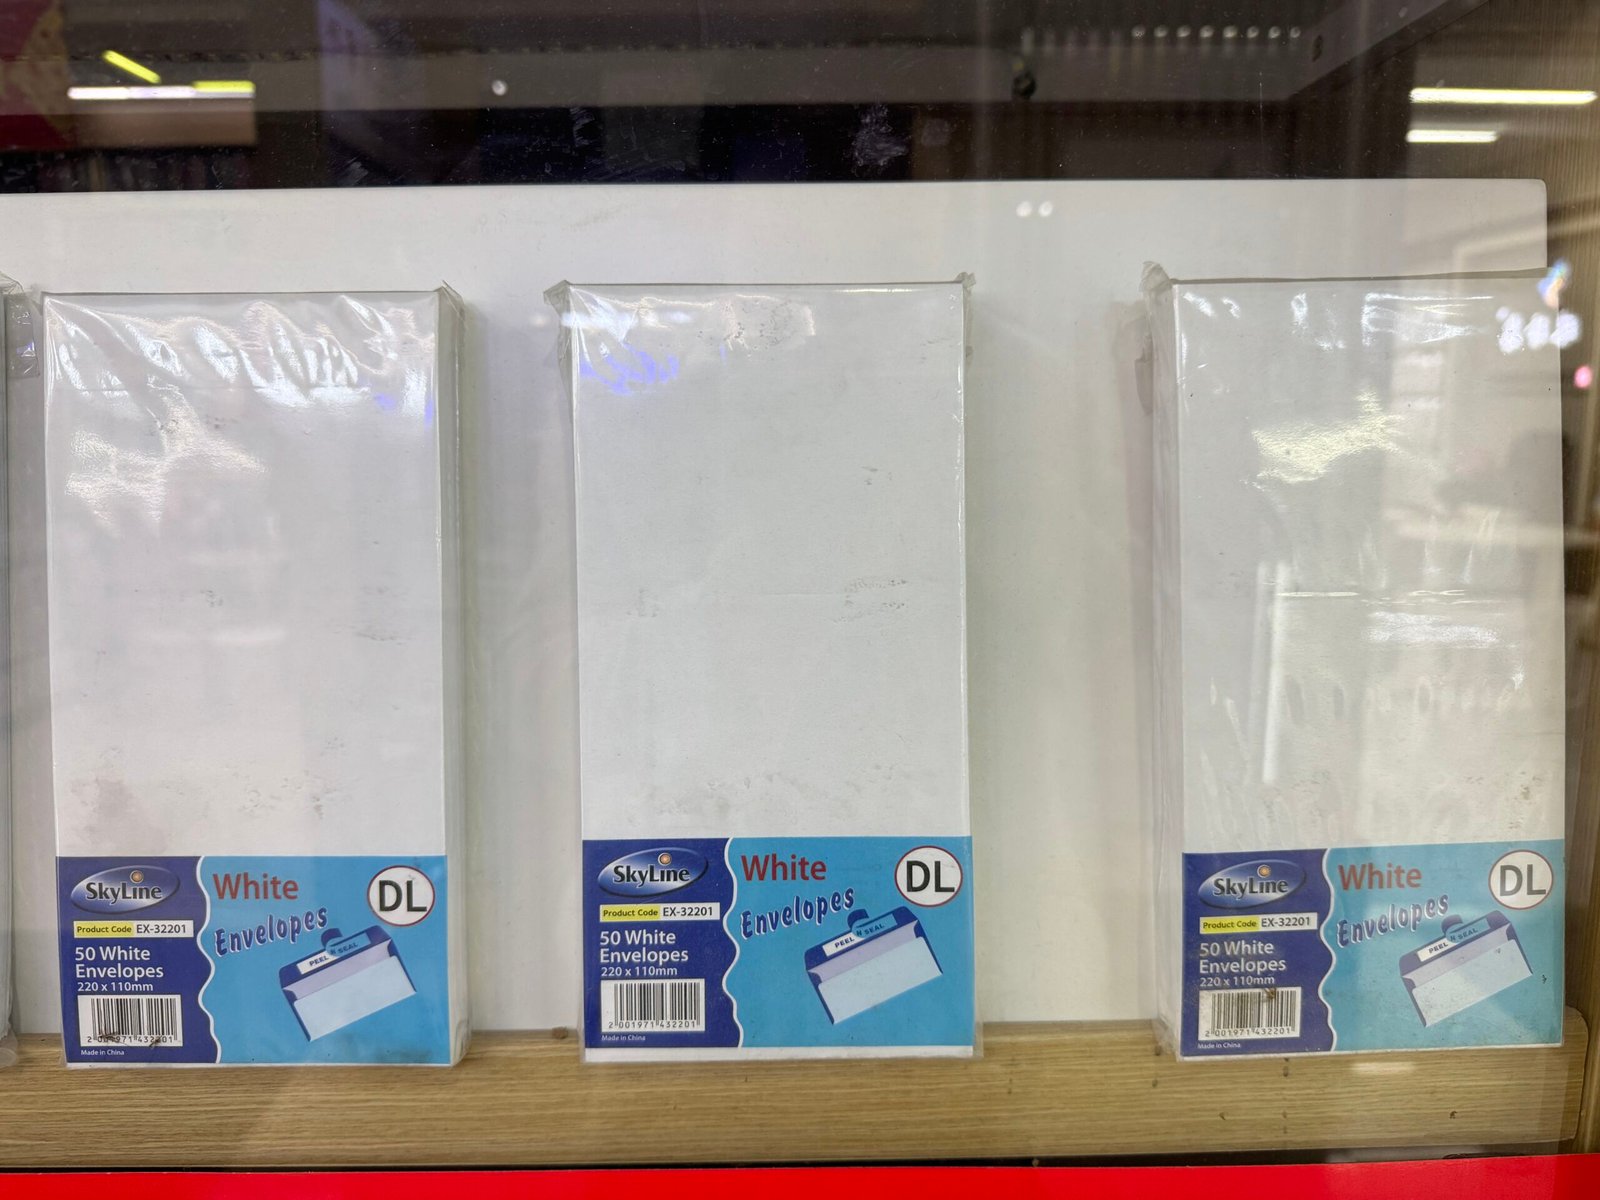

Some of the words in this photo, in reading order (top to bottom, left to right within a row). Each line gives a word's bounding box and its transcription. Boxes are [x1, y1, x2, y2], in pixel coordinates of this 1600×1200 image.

[613, 865, 691, 888] SkyLine
[741, 853, 827, 881] White
[906, 860, 955, 893] DL
[1337, 862, 1422, 891] White
[212, 872, 299, 900] White
[1213, 877, 1289, 900] SkyLine
[1500, 864, 1546, 897] DL
[85, 882, 163, 904] SkyLine
[378, 879, 428, 913] DL
[603, 909, 635, 918] Product
[638, 908, 658, 916] Code
[662, 906, 713, 917] EX-32201
[740, 887, 855, 940] Envelopes
[1337, 894, 1449, 948] Envelopes
[77, 925, 109, 933] Product
[112, 925, 132, 933] Code
[136, 924, 186, 934] EX-32201
[214, 907, 328, 957] Envelopes
[1203, 921, 1234, 930] Product
[1236, 920, 1257, 928] Code
[1261, 917, 1310, 928] EX-32201
[600, 930, 621, 946] 50
[625, 929, 676, 945] White
[834, 936, 855, 948] PEEL
[864, 923, 885, 935] SEAL
[1428, 942, 1449, 954] PEEL
[1457, 928, 1478, 940] SEAL
[75, 946, 96, 961] 50
[100, 945, 150, 961] White
[600, 947, 689, 965] Envelopes
[1200, 942, 1220, 957] 50
[1224, 940, 1274, 956] White
[75, 963, 164, 981] Envelopes
[309, 955, 330, 967] PEEL
[601, 966, 622, 977] 220
[625, 968, 632, 976] x
[635, 966, 678, 976] 110mm
[1200, 957, 1287, 975] Envelopes
[77, 981, 99, 992] 220
[112, 981, 154, 992] 110mm
[1200, 977, 1221, 987] 220
[1234, 976, 1275, 986] 110mm
